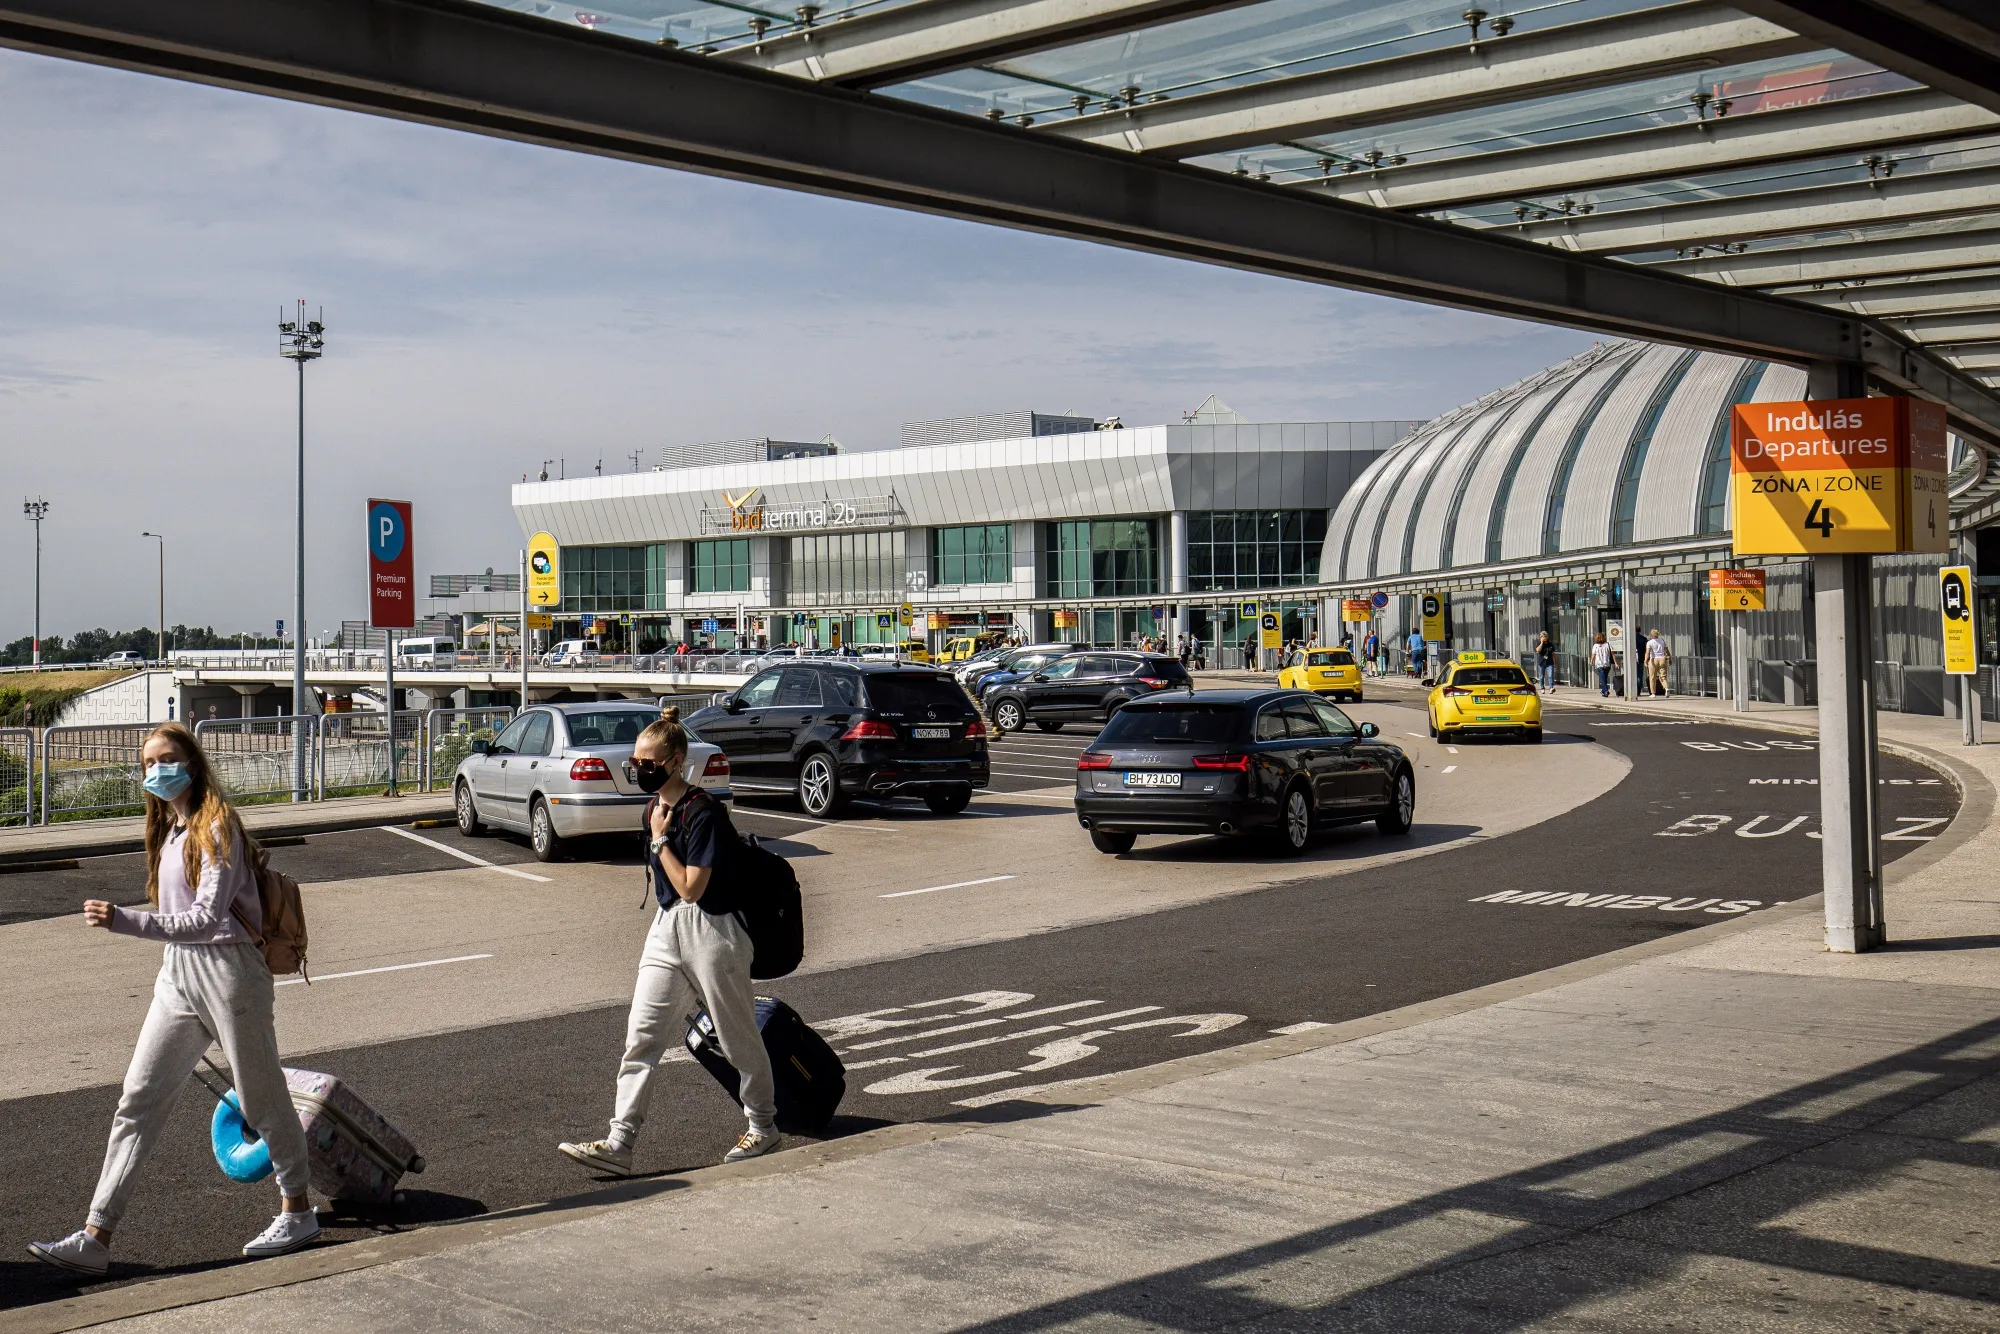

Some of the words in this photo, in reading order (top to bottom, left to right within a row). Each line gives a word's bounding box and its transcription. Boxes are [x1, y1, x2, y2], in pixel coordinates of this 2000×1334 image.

[1767, 409, 1863, 433] Indulás
[1744, 436, 1888, 462] Departures
[1751, 475, 1811, 494] ZÓNA
[1824, 475, 1883, 492] ZONE
[833, 502, 856, 525] 2b
[1804, 498, 1835, 539] 4
[1927, 498, 1936, 539] 4
[380, 516, 394, 548] P
[376, 573, 406, 584] Premium
[1724, 578, 1762, 586] Departures
[376, 587, 402, 600] Parking
[1740, 595, 1749, 606] 6
[916, 729, 949, 738] NOK-789
[1129, 773, 1143, 784] BH
[1146, 773, 1158, 784] 73
[1160, 773, 1180, 784] ADO
[1652, 814, 1950, 841] BUZ
